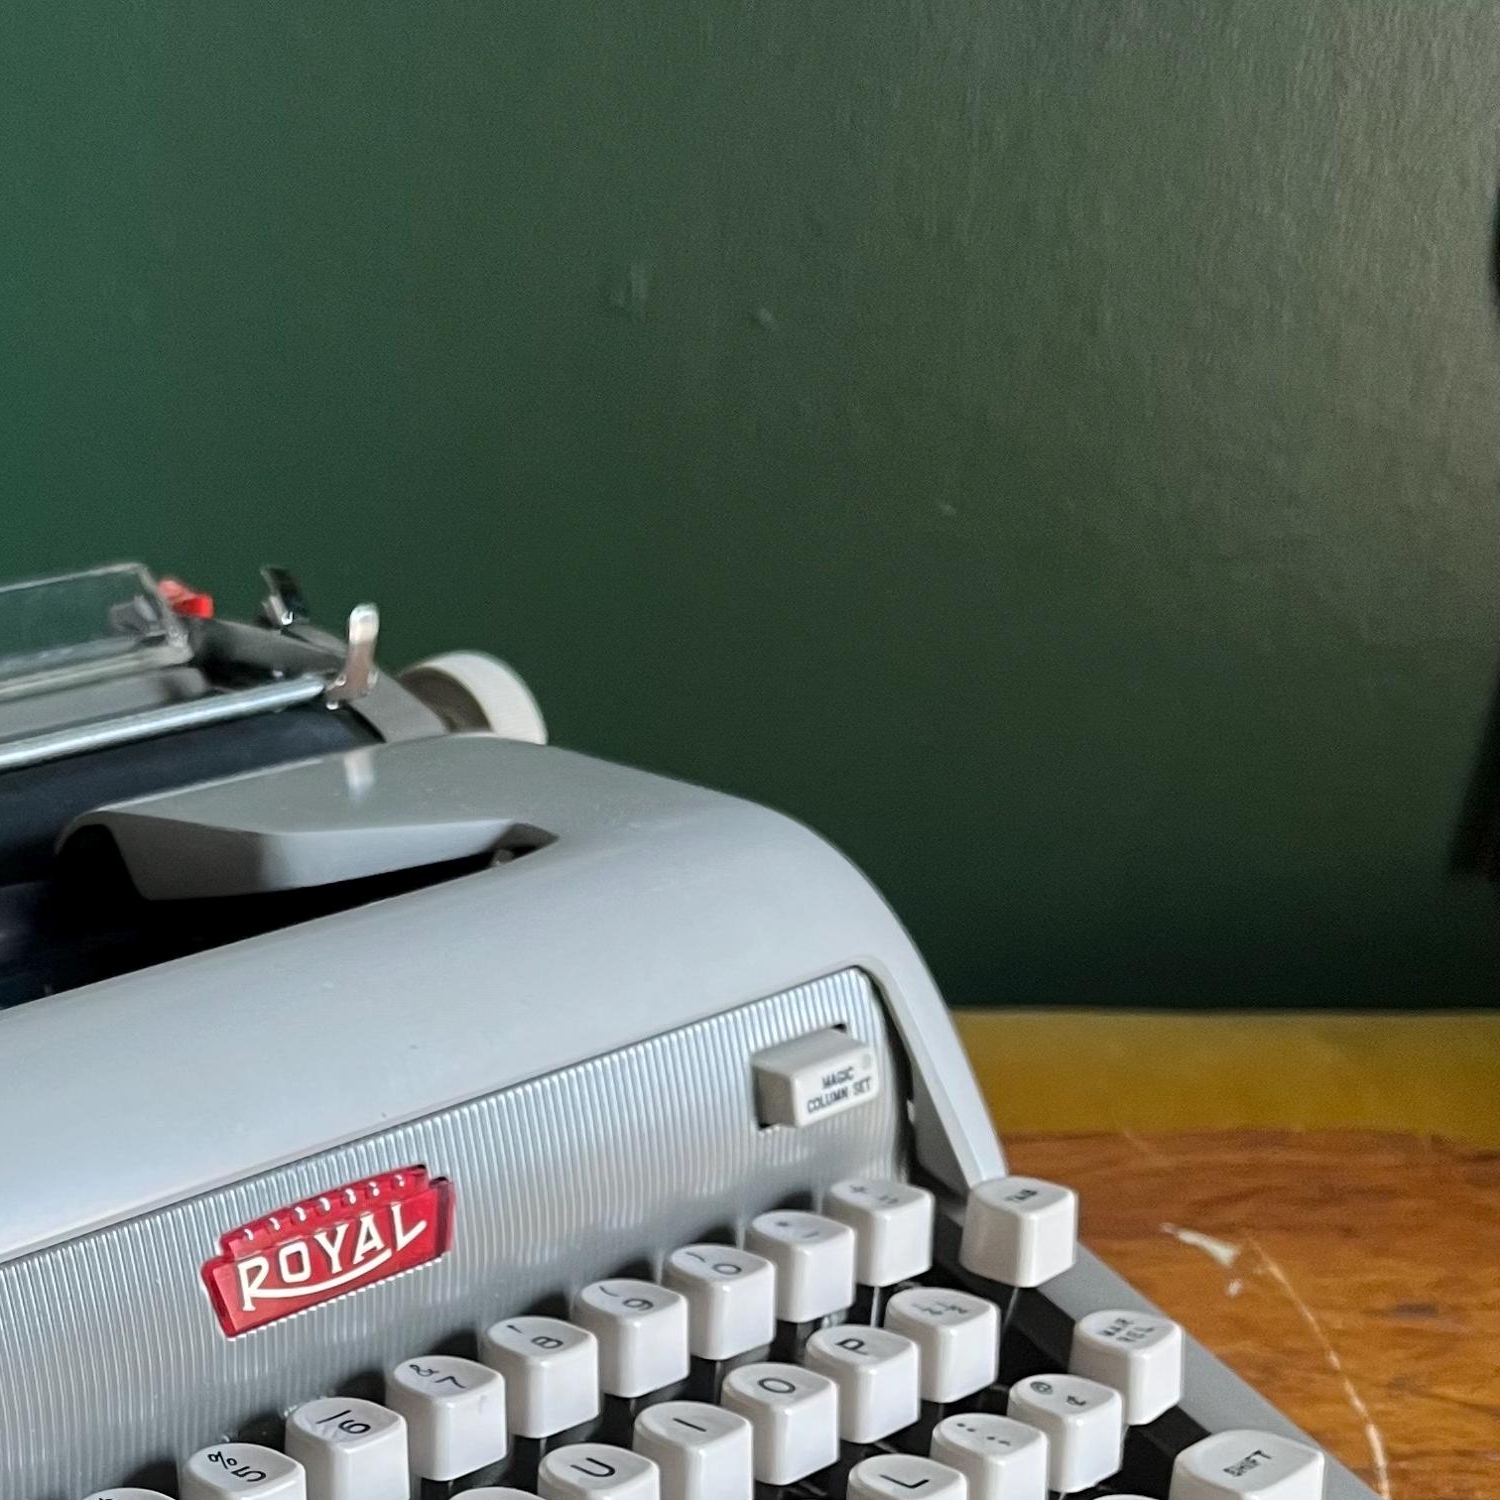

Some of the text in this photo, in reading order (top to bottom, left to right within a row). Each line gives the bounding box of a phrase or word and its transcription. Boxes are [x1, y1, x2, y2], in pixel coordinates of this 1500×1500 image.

[853, 1076, 872, 1097] SET
[237, 1202, 428, 1312] ROYAL
[622, 1297, 655, 1311] 9
[530, 1335, 565, 1350] 8
[835, 1337, 868, 1356] P
[434, 1375, 467, 1389] 7
[1029, 1380, 1054, 1396] @
[337, 1419, 372, 1435] 6
[207, 1450, 238, 1470] %
[570, 1457, 616, 1478] U
[230, 1465, 267, 1483] 5
[879, 1474, 930, 1489] L
